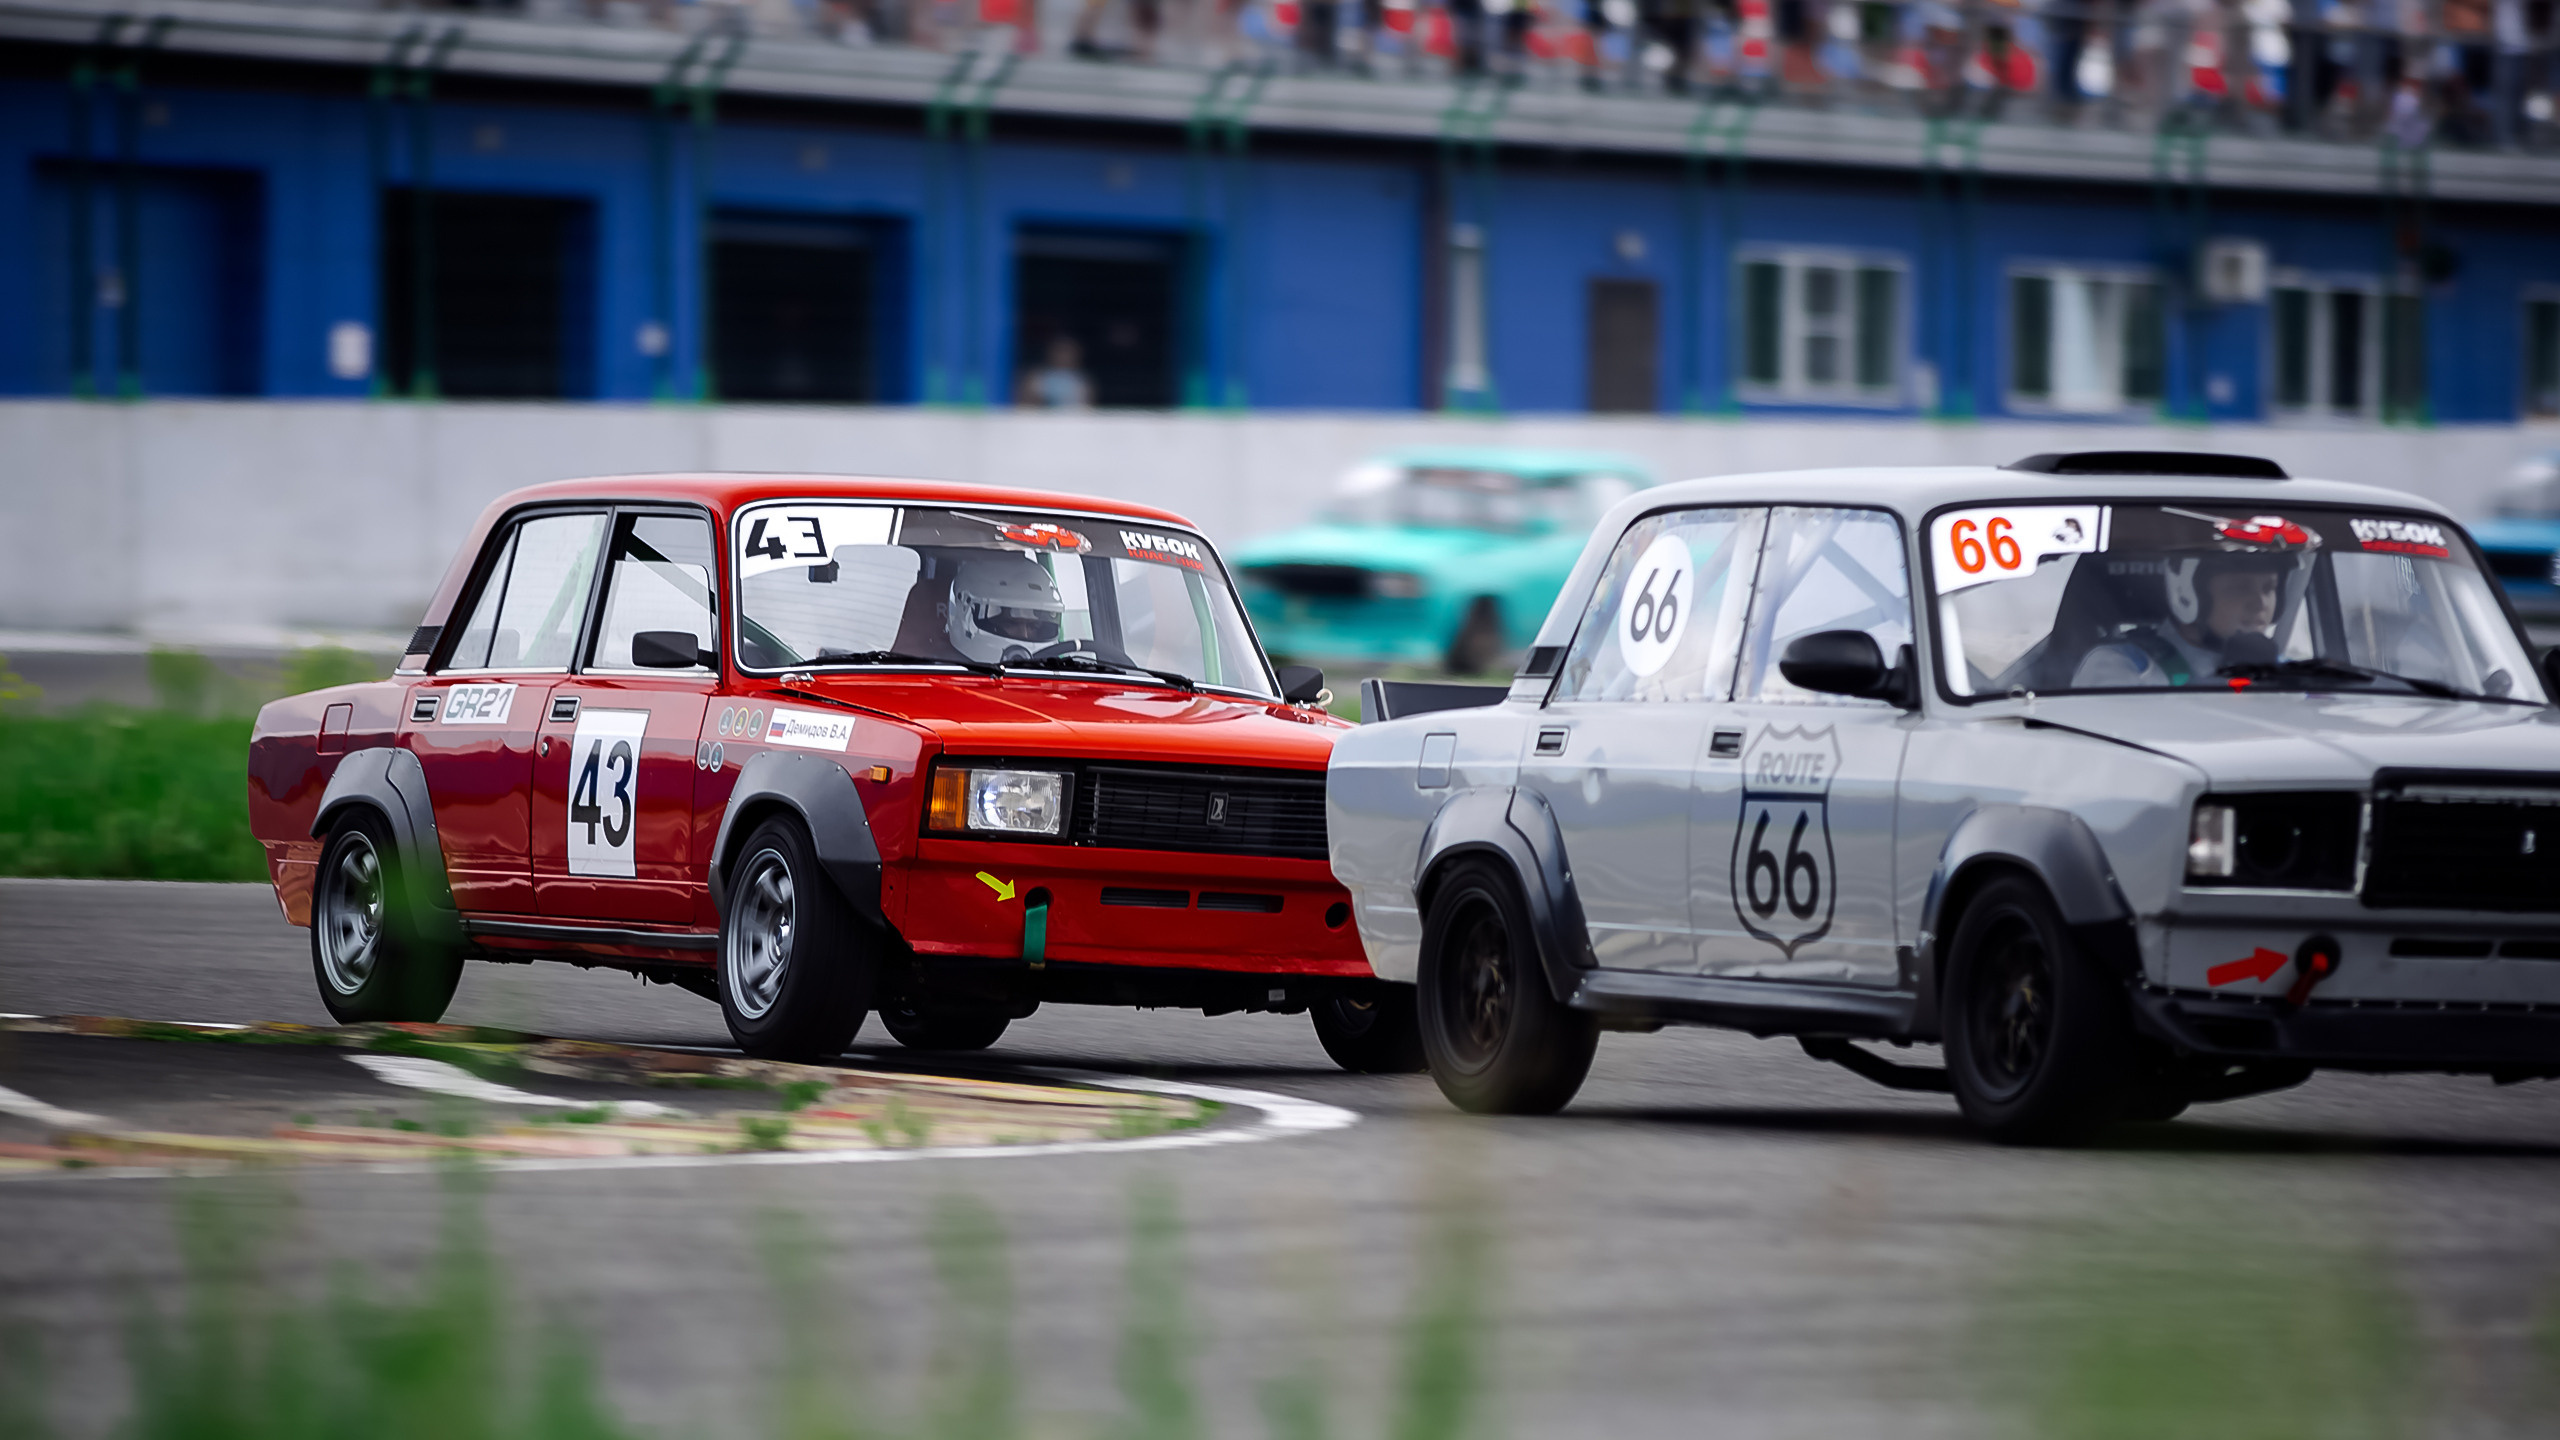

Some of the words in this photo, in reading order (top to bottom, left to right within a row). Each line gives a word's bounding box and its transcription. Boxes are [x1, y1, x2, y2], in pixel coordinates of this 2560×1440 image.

[745, 516, 828, 560] 43
[1119, 530, 1202, 561] КУБОК
[1950, 517, 2022, 574] 66
[1630, 567, 1683, 644] 66
[445, 687, 510, 719] GR21
[785, 719, 828, 739] Демидов
[1755, 751, 1826, 785] ROUTE
[571, 738, 633, 848] 43
[1746, 808, 1820, 921] 66
